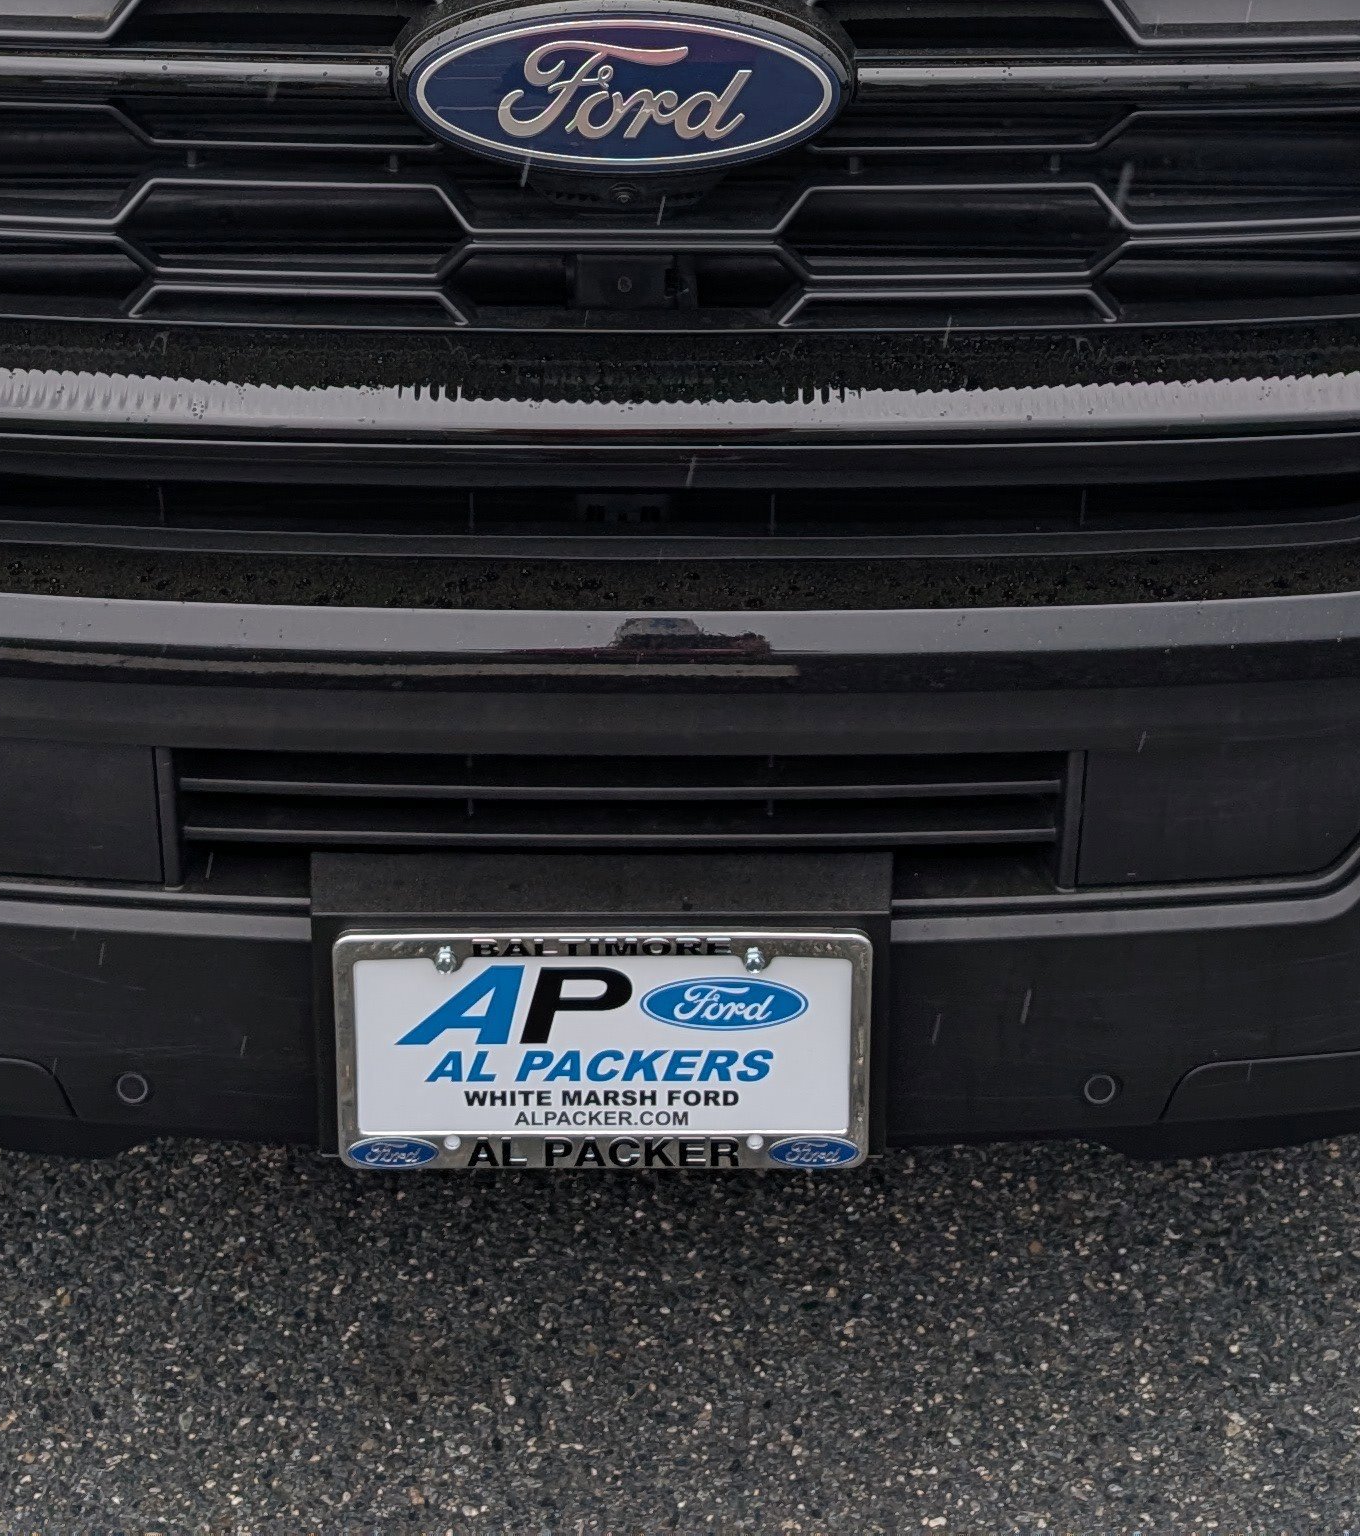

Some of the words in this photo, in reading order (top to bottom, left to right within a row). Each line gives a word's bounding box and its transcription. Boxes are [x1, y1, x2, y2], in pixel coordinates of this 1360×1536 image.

[497, 39, 753, 140] Ford
[471, 938, 733, 957] BALTIMORE
[394, 965, 634, 1046] AP
[672, 989, 776, 1023] Ford
[423, 1050, 496, 1083] AL
[514, 1049, 774, 1083] PACKERS
[463, 1090, 552, 1107] WHITE
[561, 1090, 657, 1107] MARSH
[667, 1090, 740, 1107] FORD
[514, 1110, 690, 1127] ALPACKER.COM
[363, 1141, 424, 1164] Ford
[467, 1136, 528, 1167] AL
[543, 1136, 740, 1167] PACKER
[784, 1140, 842, 1164] Ford
